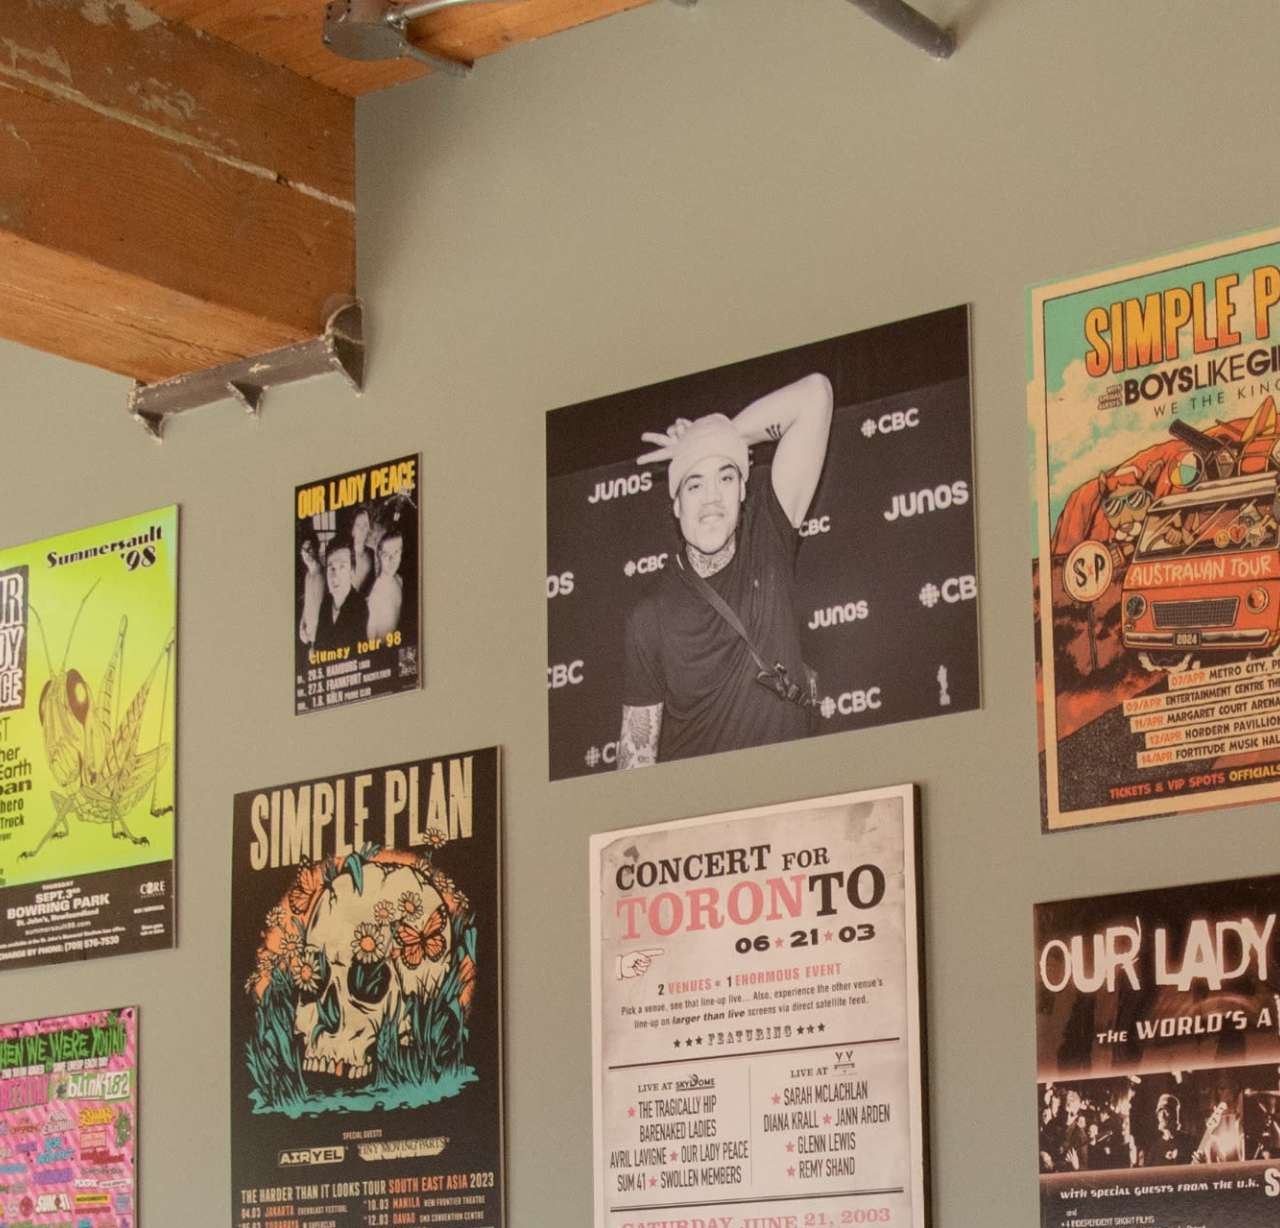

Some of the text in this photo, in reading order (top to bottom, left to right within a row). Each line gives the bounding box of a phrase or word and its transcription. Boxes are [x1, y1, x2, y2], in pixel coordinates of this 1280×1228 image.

[1084, 273, 1242, 379] SIMPLE
[1154, 403, 1179, 418] WE
[1190, 391, 1224, 411] THE
[878, 408, 920, 434] CBC
[297, 460, 417, 519] OUR LADY PEACE
[47, 525, 163, 569] Summersault
[637, 553, 668, 574] CBC
[1128, 554, 1271, 588] AUSTRALIAN TOUR
[308, 631, 401, 665] clumsy tour 98
[837, 687, 882, 715] CBC
[249, 756, 474, 872] SIMPLE PLAN
[615, 844, 831, 892] CONCERT FOR
[6, 900, 70, 920] BOWRING
[73, 894, 110, 909] PARK
[615, 864, 886, 941] TORONTO
[735, 924, 876, 955] 06 21 03
[1040, 915, 1143, 993] OUR
[1155, 913, 1277, 992] LADY
[1136, 1010, 1248, 1041] WORLD'S
[1257, 1010, 1272, 1027] A
[640, 1119, 717, 1143] BARENAKED LADIES
[841, 1207, 892, 1225] 2003
